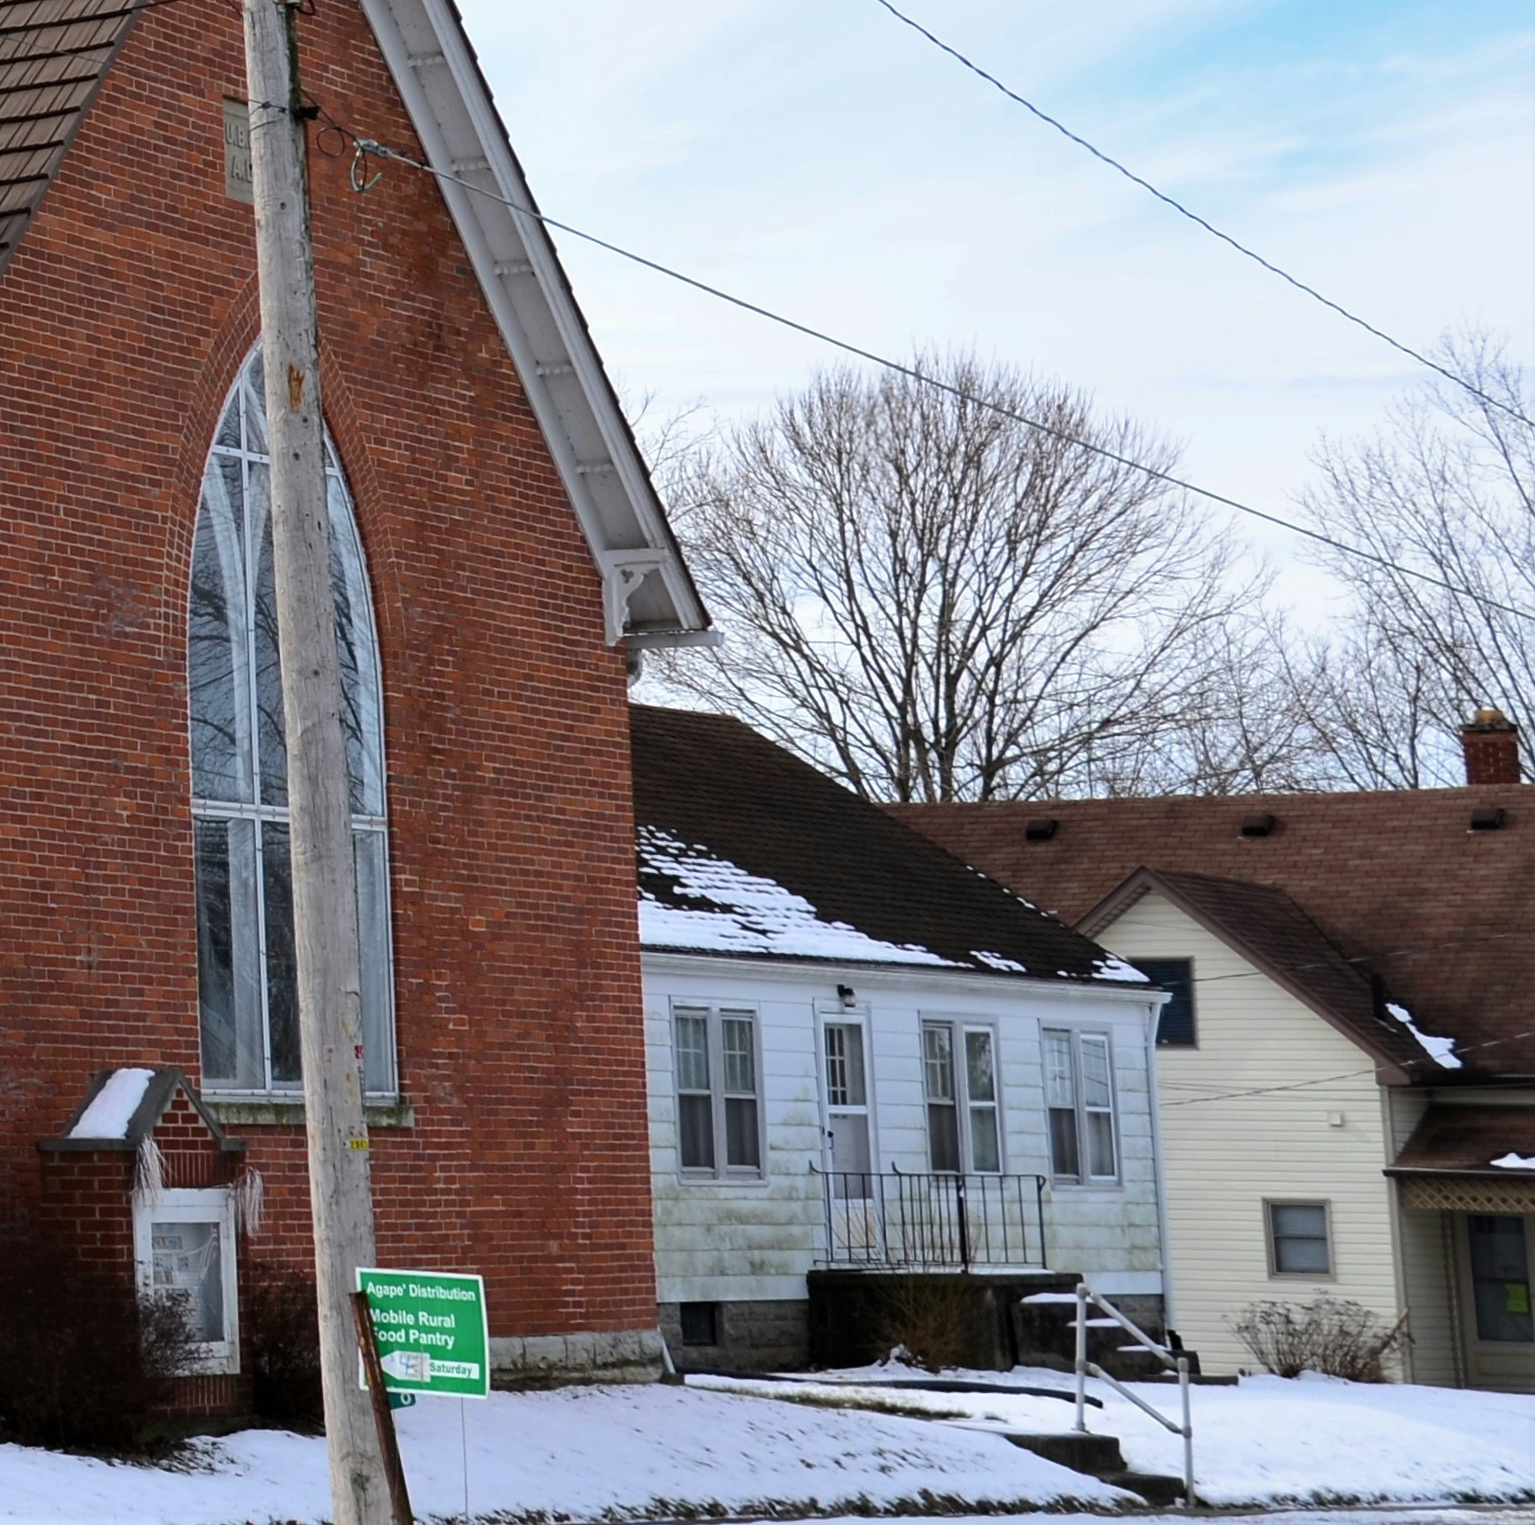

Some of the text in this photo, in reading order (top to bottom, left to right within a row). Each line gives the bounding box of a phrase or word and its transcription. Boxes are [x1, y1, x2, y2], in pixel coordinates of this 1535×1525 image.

[409, 1284, 476, 1301] Distribution
[370, 1308, 455, 1328] Mobile Rural
[409, 1329, 455, 1350] Pantry
[430, 1362, 473, 1378] Saturday
